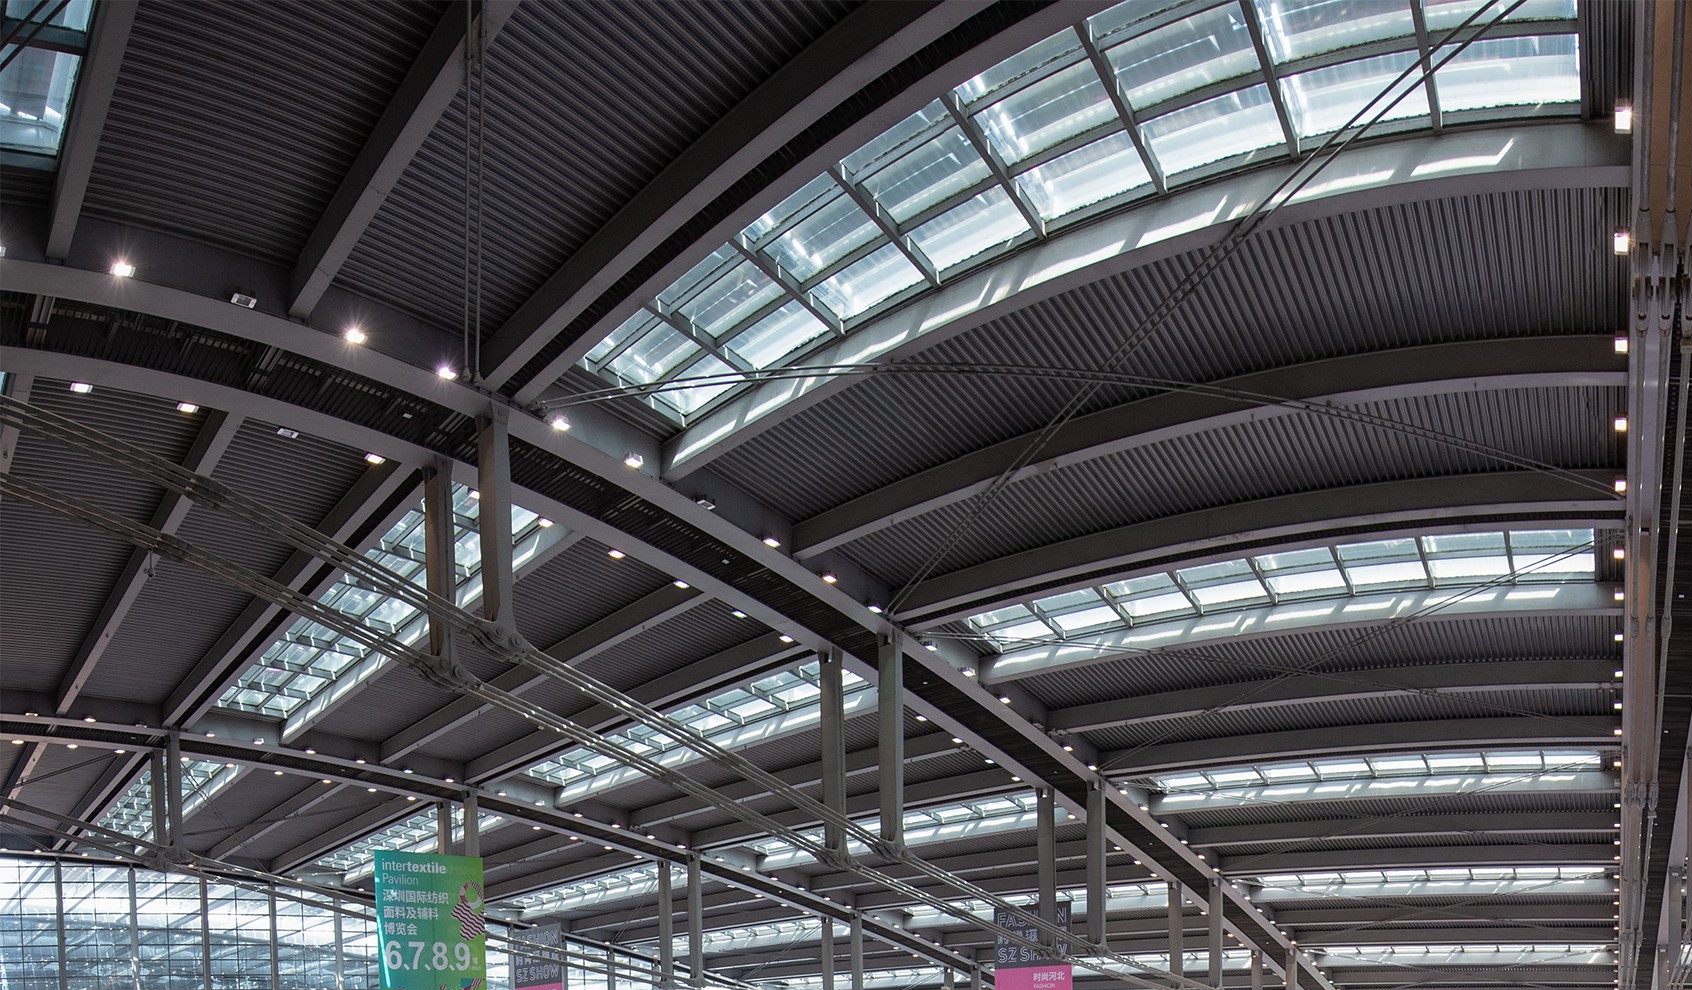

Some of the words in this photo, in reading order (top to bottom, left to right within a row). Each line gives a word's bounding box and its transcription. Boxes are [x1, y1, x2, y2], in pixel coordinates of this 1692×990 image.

[381, 858, 447, 874] intertextile
[382, 873, 419, 885] Pavilion
[383, 888, 449, 904] 深圳国际纺织
[383, 905, 439, 920] 面料及辅料
[384, 922, 418, 936] 博览会
[997, 946, 1017, 964] SZ
[529, 963, 560, 982] SHOW
[1033, 971, 1066, 982] 时尚河北
